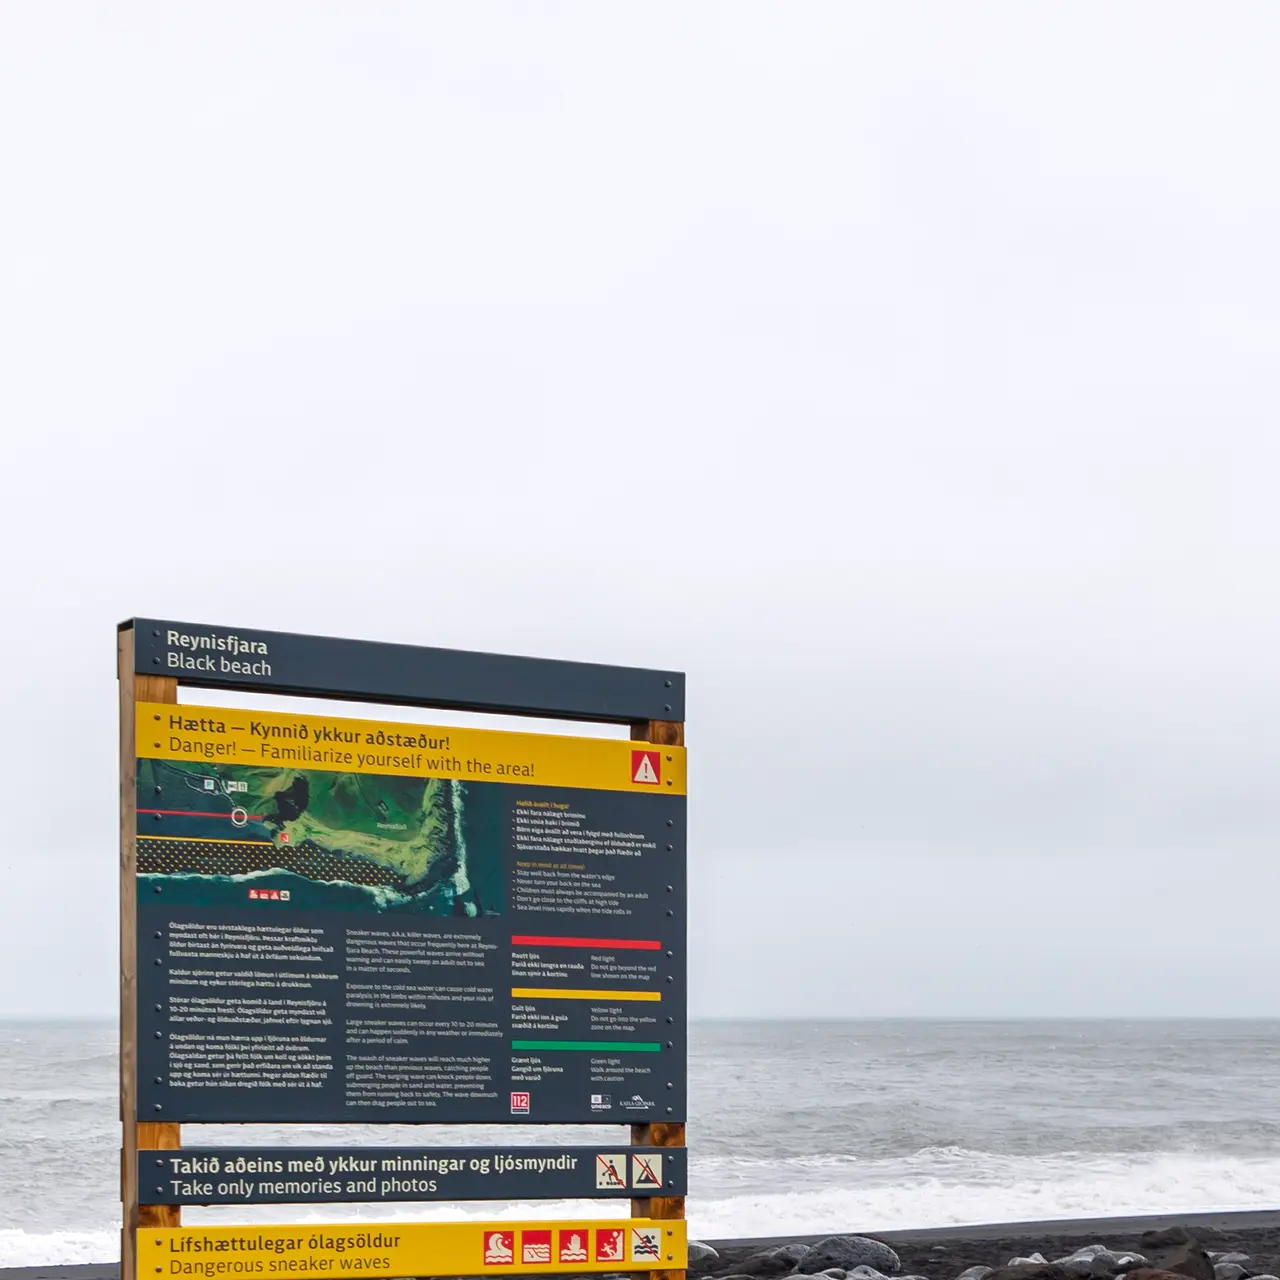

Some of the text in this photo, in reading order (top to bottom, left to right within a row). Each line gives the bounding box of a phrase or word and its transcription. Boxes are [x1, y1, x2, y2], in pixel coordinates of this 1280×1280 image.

[167, 630, 268, 655] Reynisfjara
[168, 652, 271, 676] Black beach
[170, 715, 226, 733] Hætta
[251, 721, 308, 740] Kynnið
[313, 726, 361, 743] ykkur
[366, 730, 449, 750] aðstæður!
[170, 737, 236, 758] Danger!
[261, 743, 352, 764] Familiarize
[357, 754, 422, 768] yourself
[426, 756, 461, 772] with
[467, 758, 491, 774] the
[497, 764, 534, 777] area!
[513, 1096, 527, 1107] 112
[170, 1155, 577, 1175] Takið aðeins með ykkur minningar og ljósmyndir
[170, 1177, 437, 1198] Take only memories and photos
[170, 1233, 400, 1254] Lífshættulegar ólagsöldur
[171, 1256, 390, 1277] Dangerous sneaker waves
